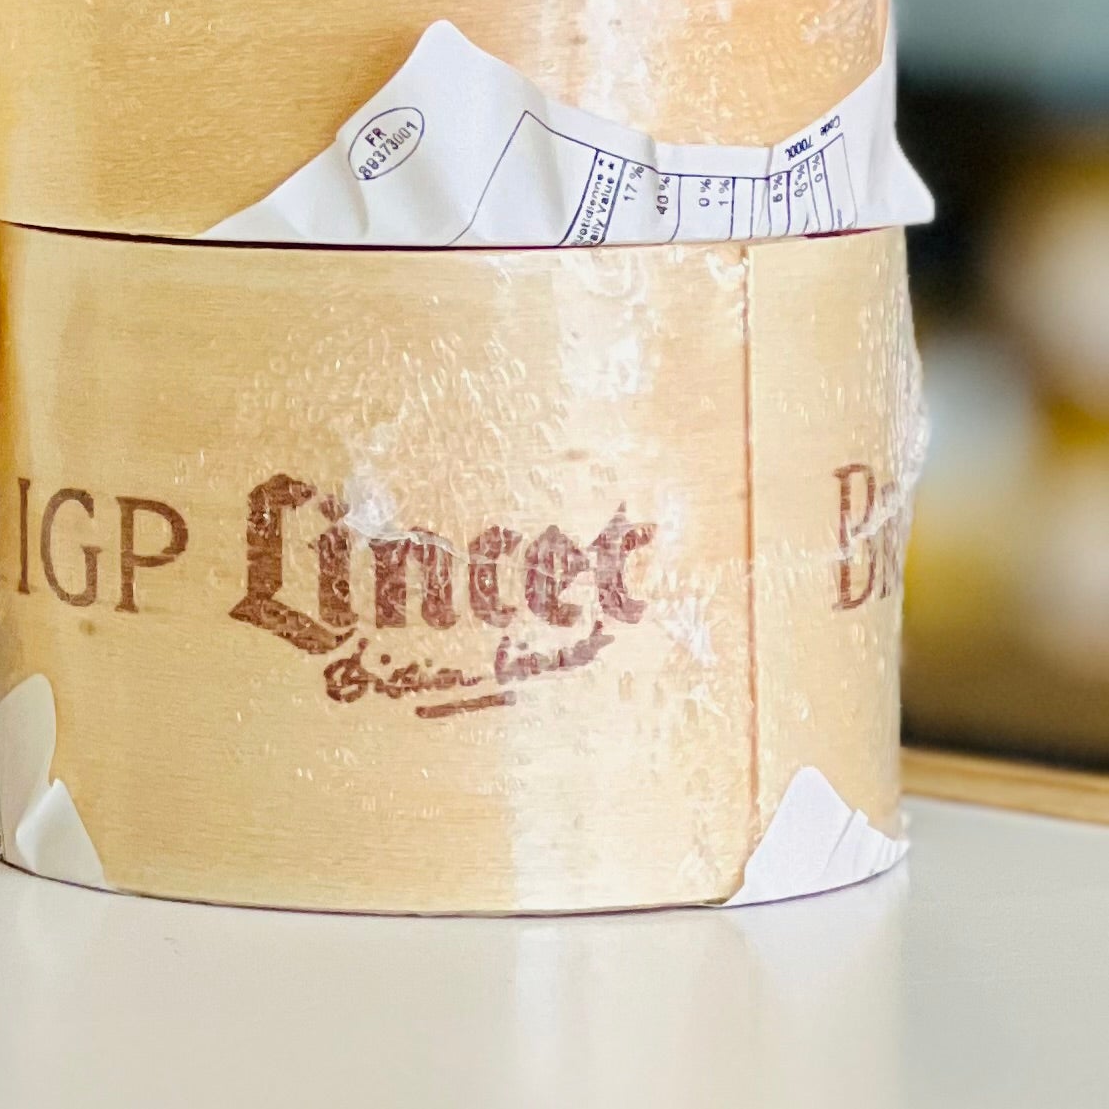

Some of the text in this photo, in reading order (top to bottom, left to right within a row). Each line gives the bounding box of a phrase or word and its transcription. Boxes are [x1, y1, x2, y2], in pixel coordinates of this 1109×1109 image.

[365, 128, 387, 147] FR
[574, 173, 604, 244] uotidienne
[585, 177, 615, 244] aily Value
[623, 183, 637, 201] 17
[656, 195, 669, 214] 40
[18, 477, 189, 613] IGP
[229, 473, 658, 654] Lincet
